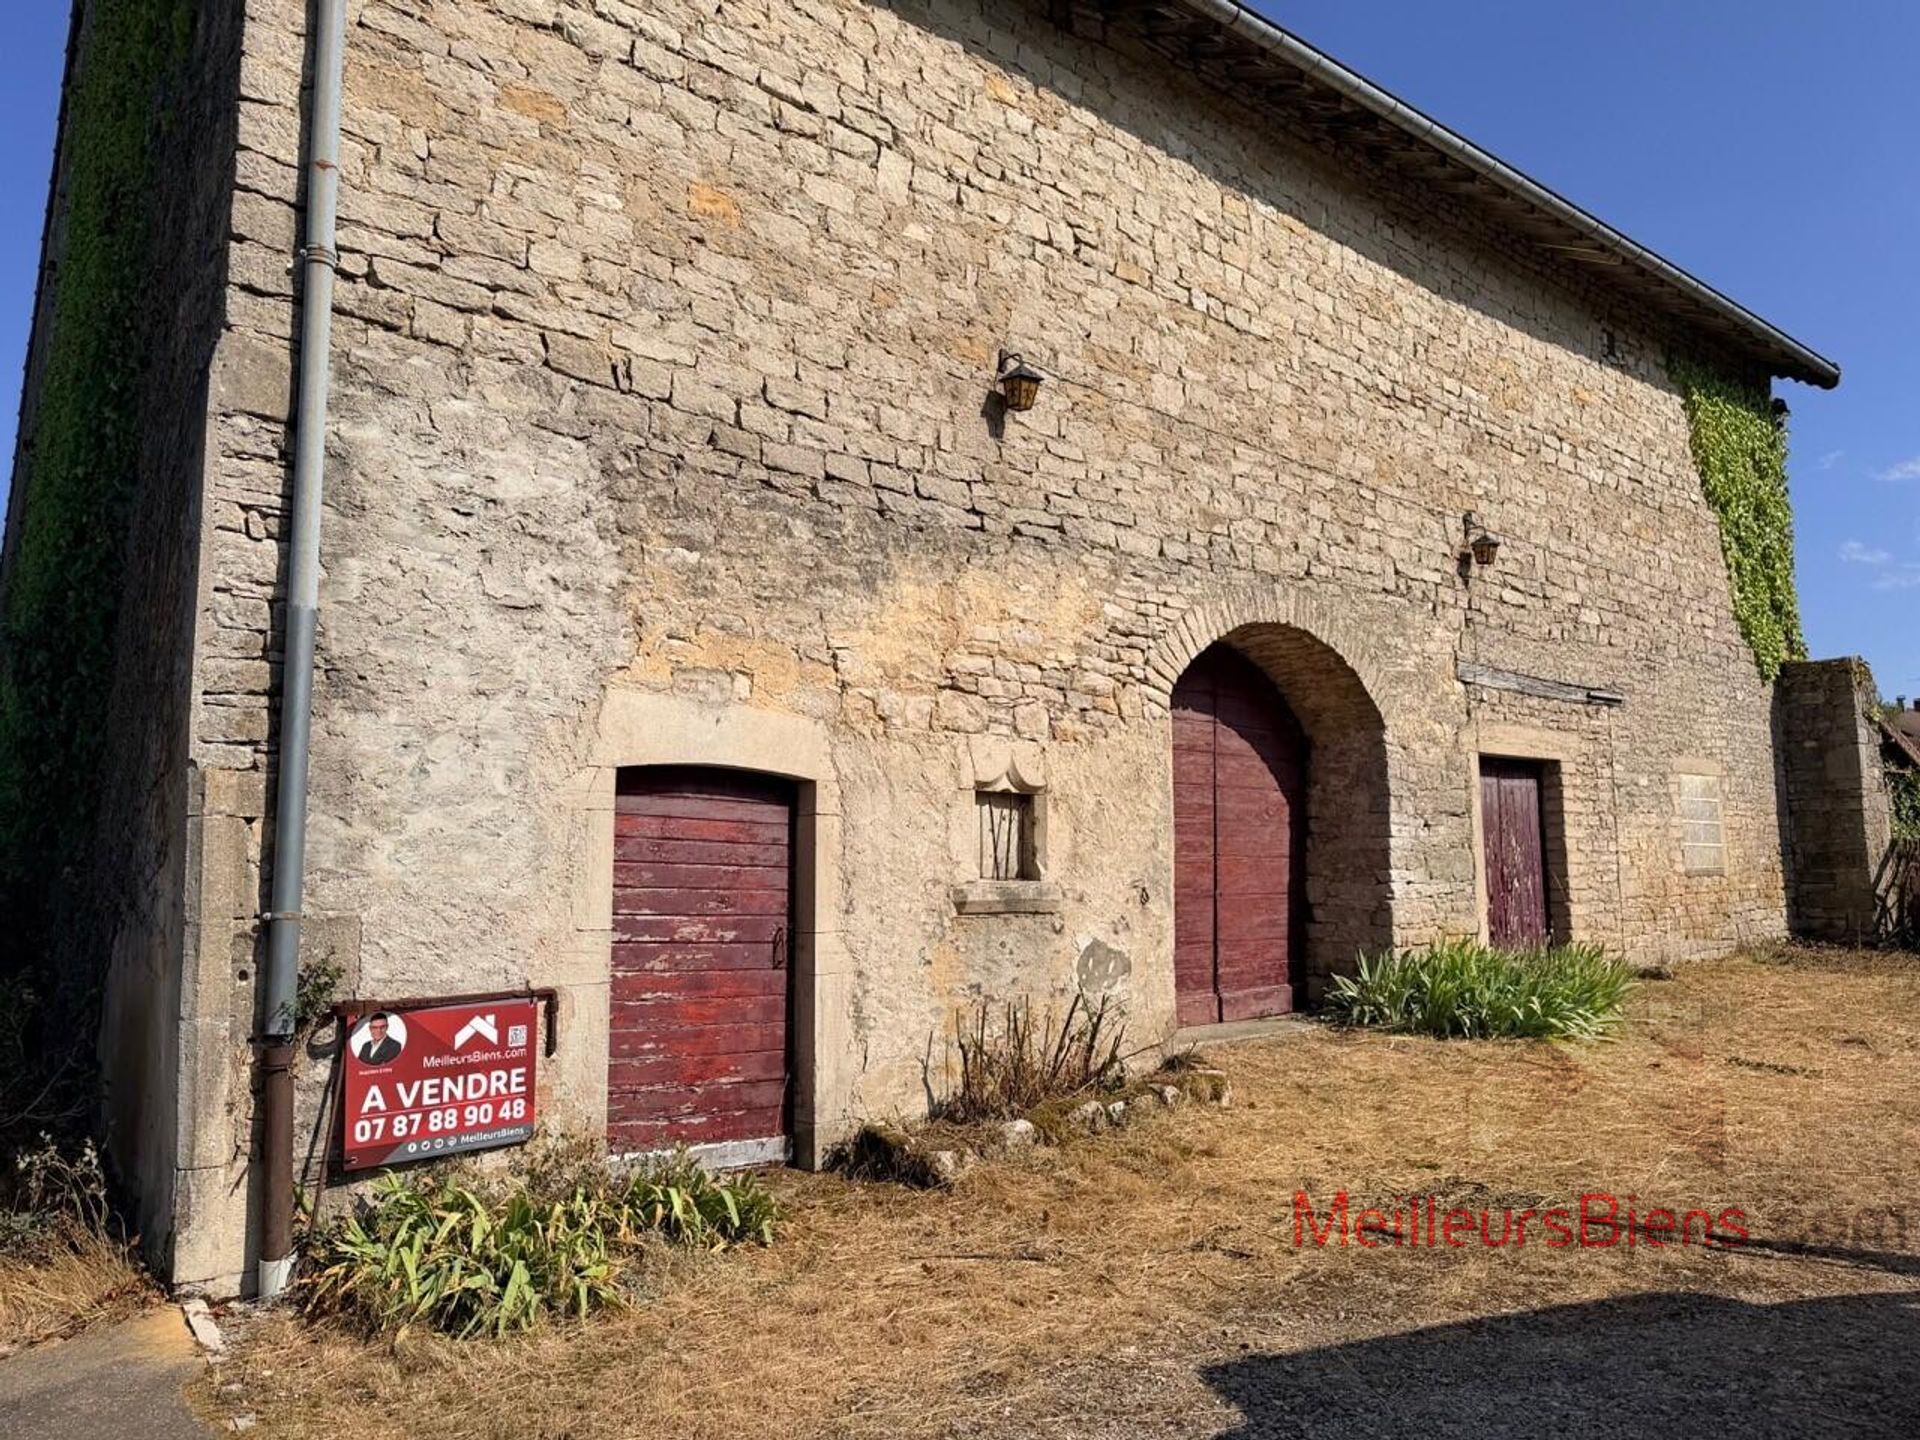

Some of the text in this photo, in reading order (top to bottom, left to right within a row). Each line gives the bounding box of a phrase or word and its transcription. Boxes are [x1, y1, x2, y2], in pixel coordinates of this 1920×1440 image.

[422, 1048, 527, 1069] MeilleursBiens.com
[361, 1067, 527, 1114] A VENDRE
[354, 1098, 526, 1143] 07 87 88 90 48
[460, 1126, 524, 1144] MeilleursBiens
